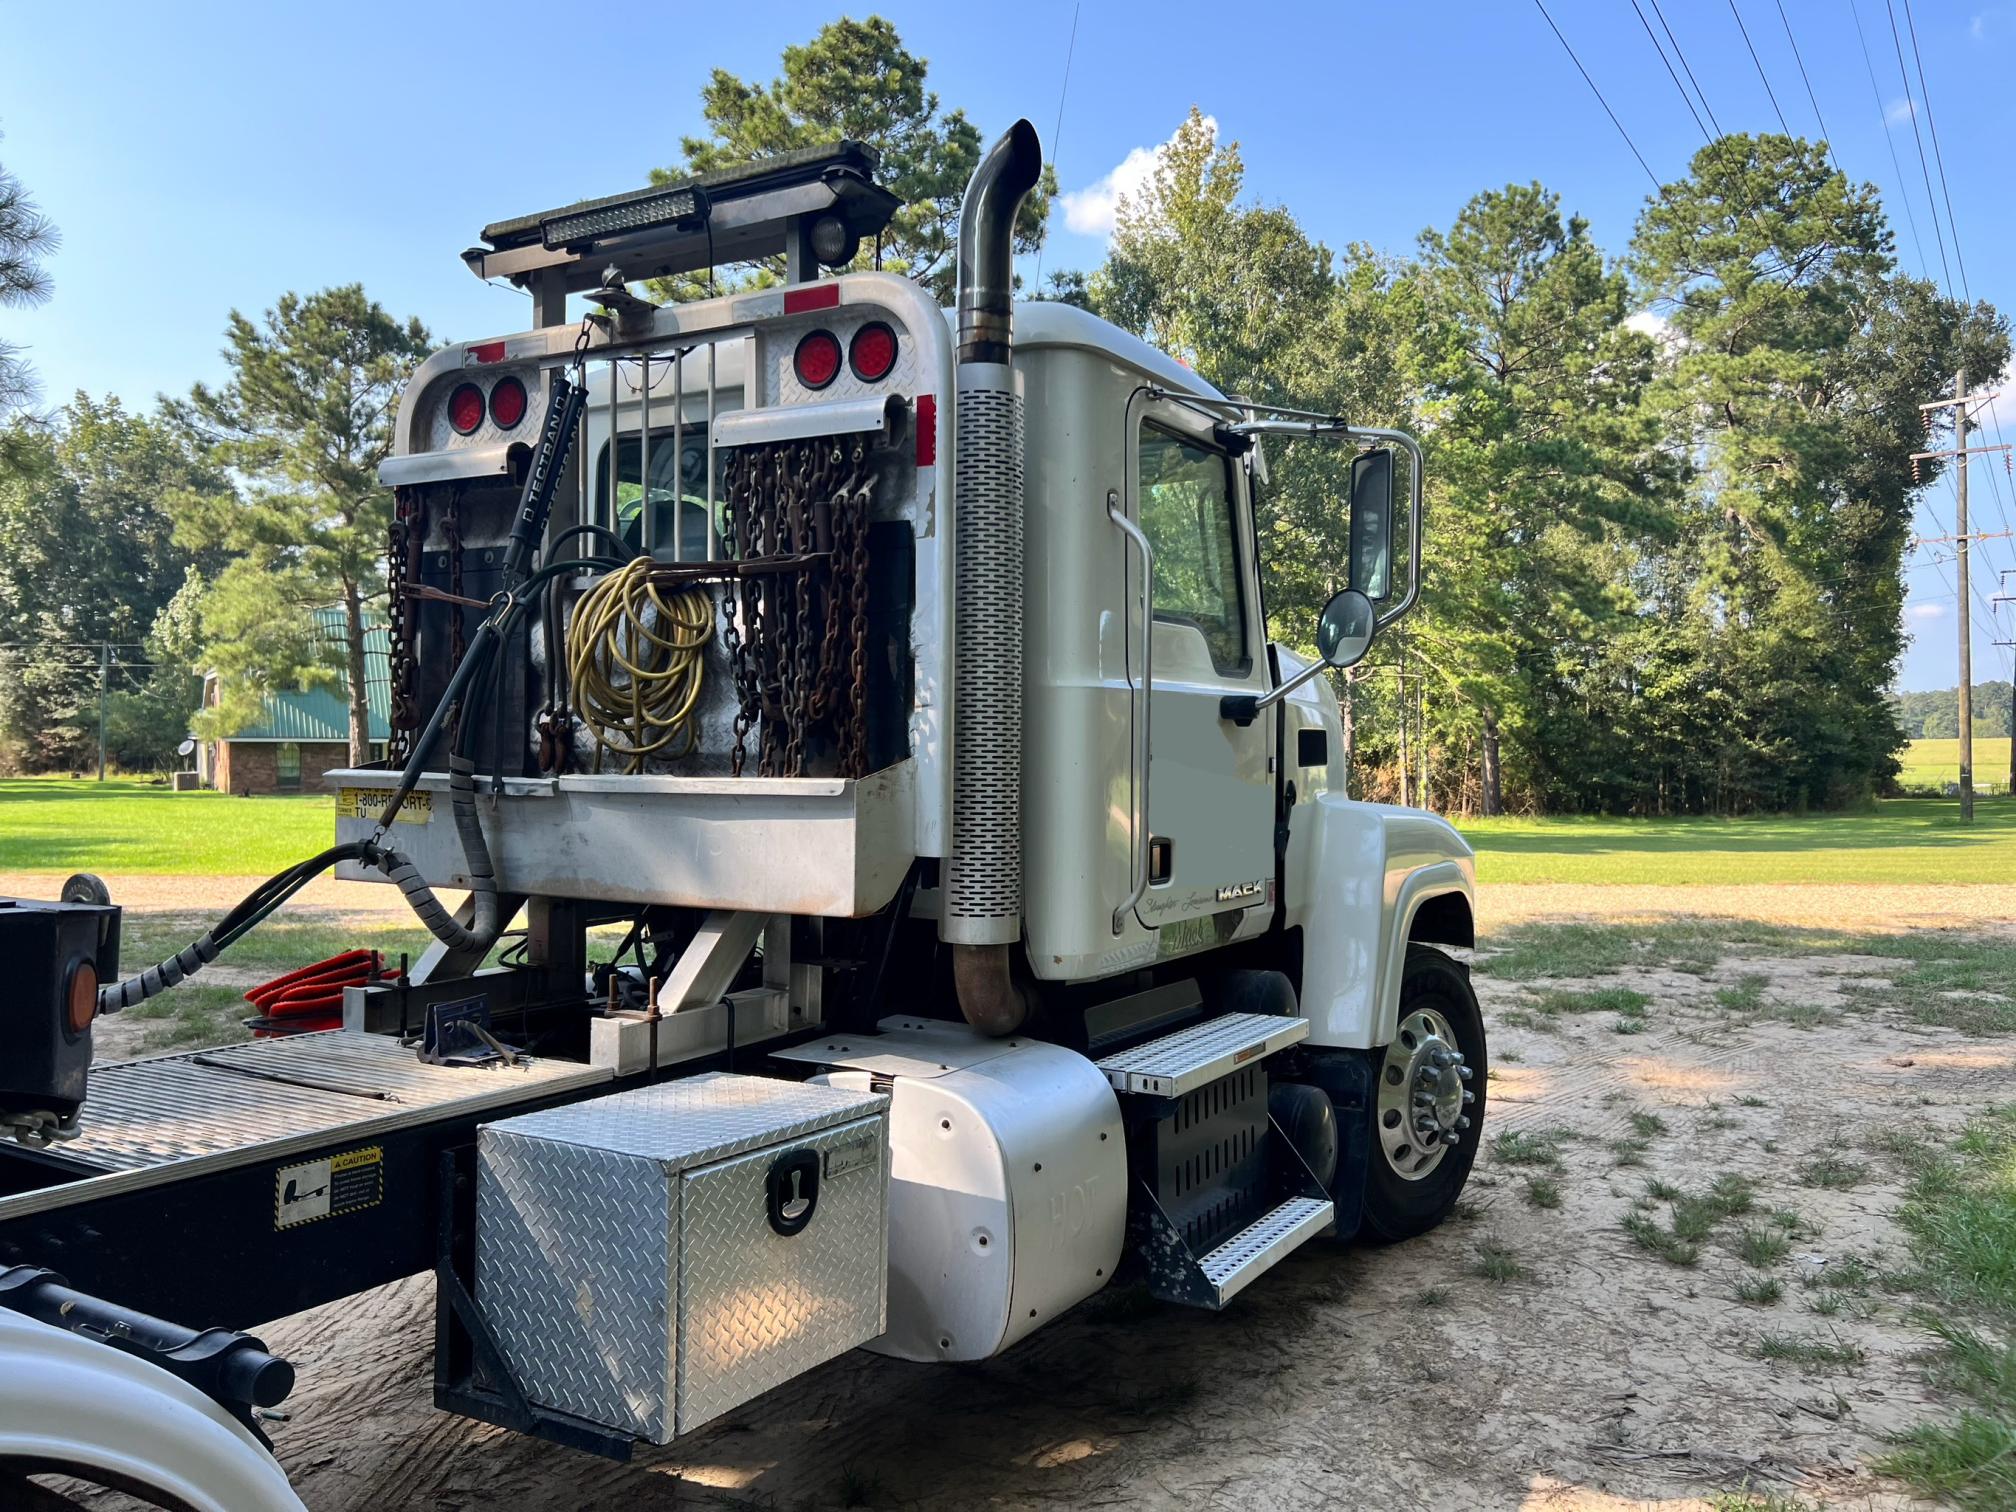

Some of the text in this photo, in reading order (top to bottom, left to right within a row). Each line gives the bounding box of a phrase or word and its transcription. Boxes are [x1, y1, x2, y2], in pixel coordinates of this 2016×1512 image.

[528, 416, 560, 507] TECTRAN
[1216, 880, 1264, 902] MACK
[343, 1152, 377, 1168] CAUTION
